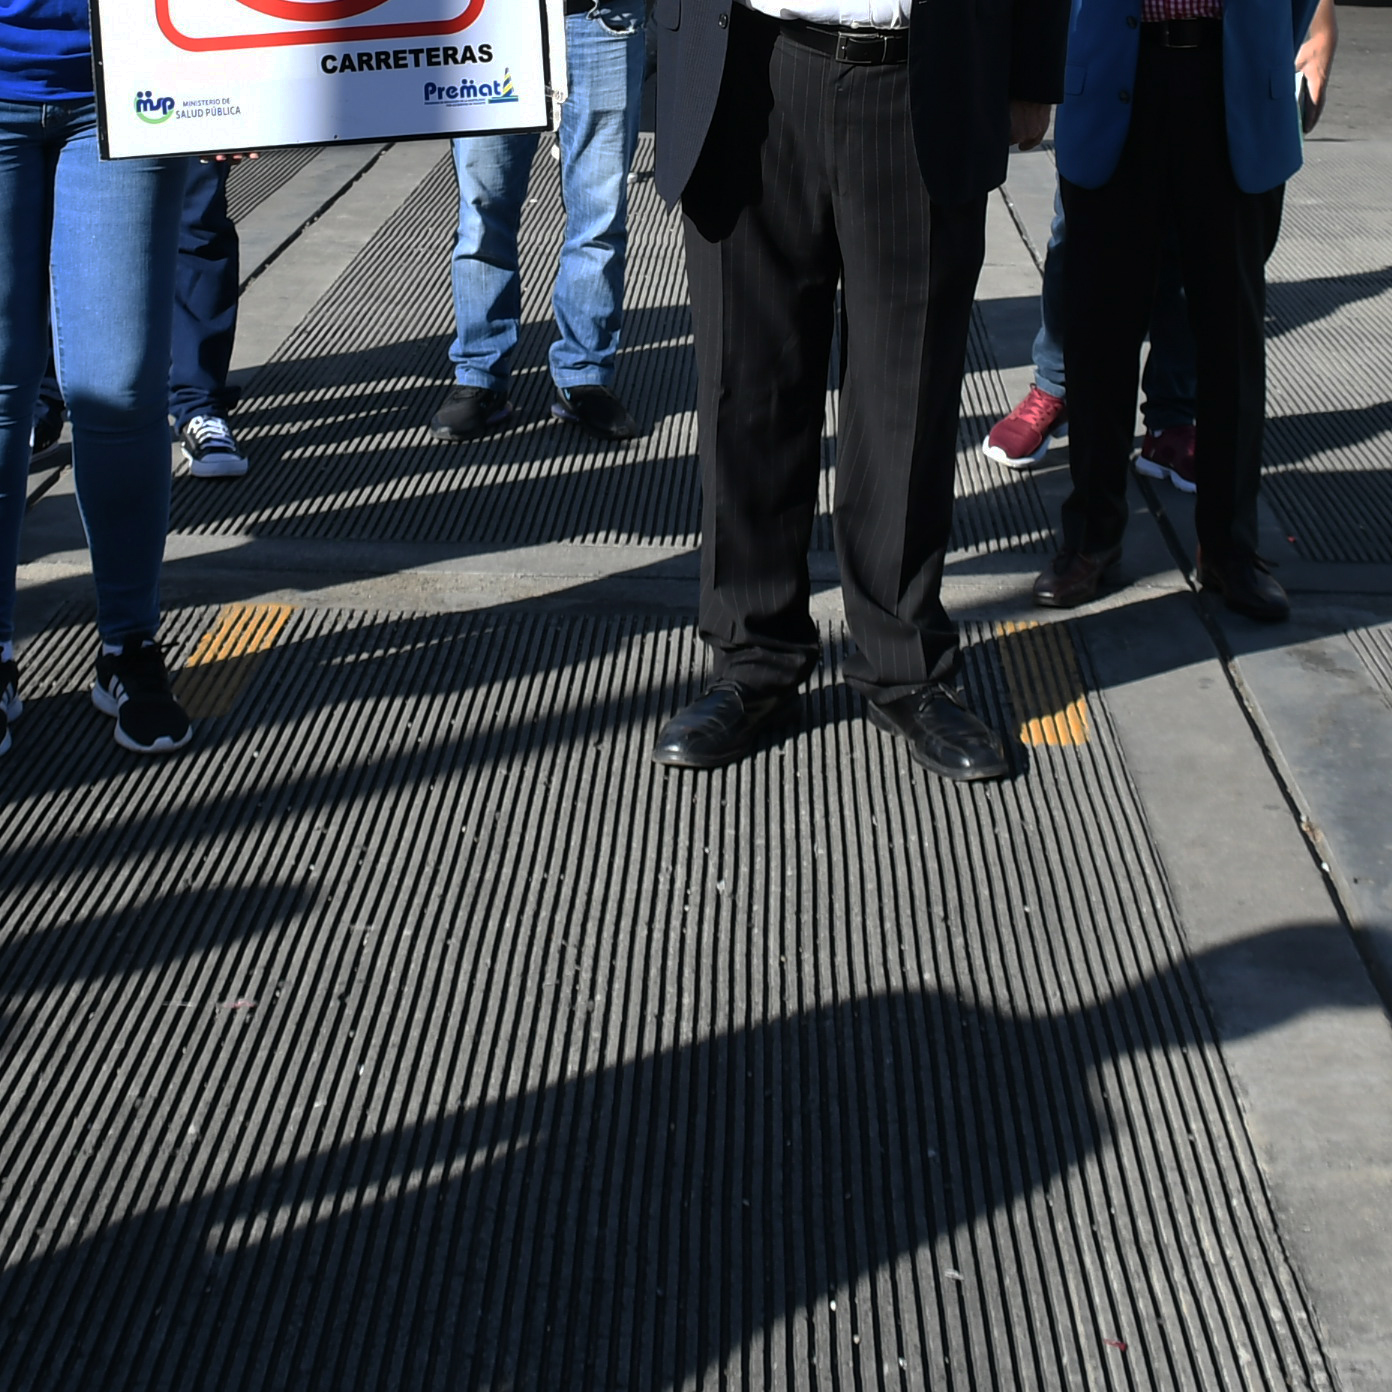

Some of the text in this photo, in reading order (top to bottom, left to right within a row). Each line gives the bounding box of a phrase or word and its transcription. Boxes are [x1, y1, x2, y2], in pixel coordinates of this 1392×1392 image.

[321, 44, 494, 75] CARRETERAS
[423, 79, 502, 101] Premat
[182, 97, 230, 107] MINISTERIO DE
[175, 105, 241, 120] SALUD PÚBLICA
